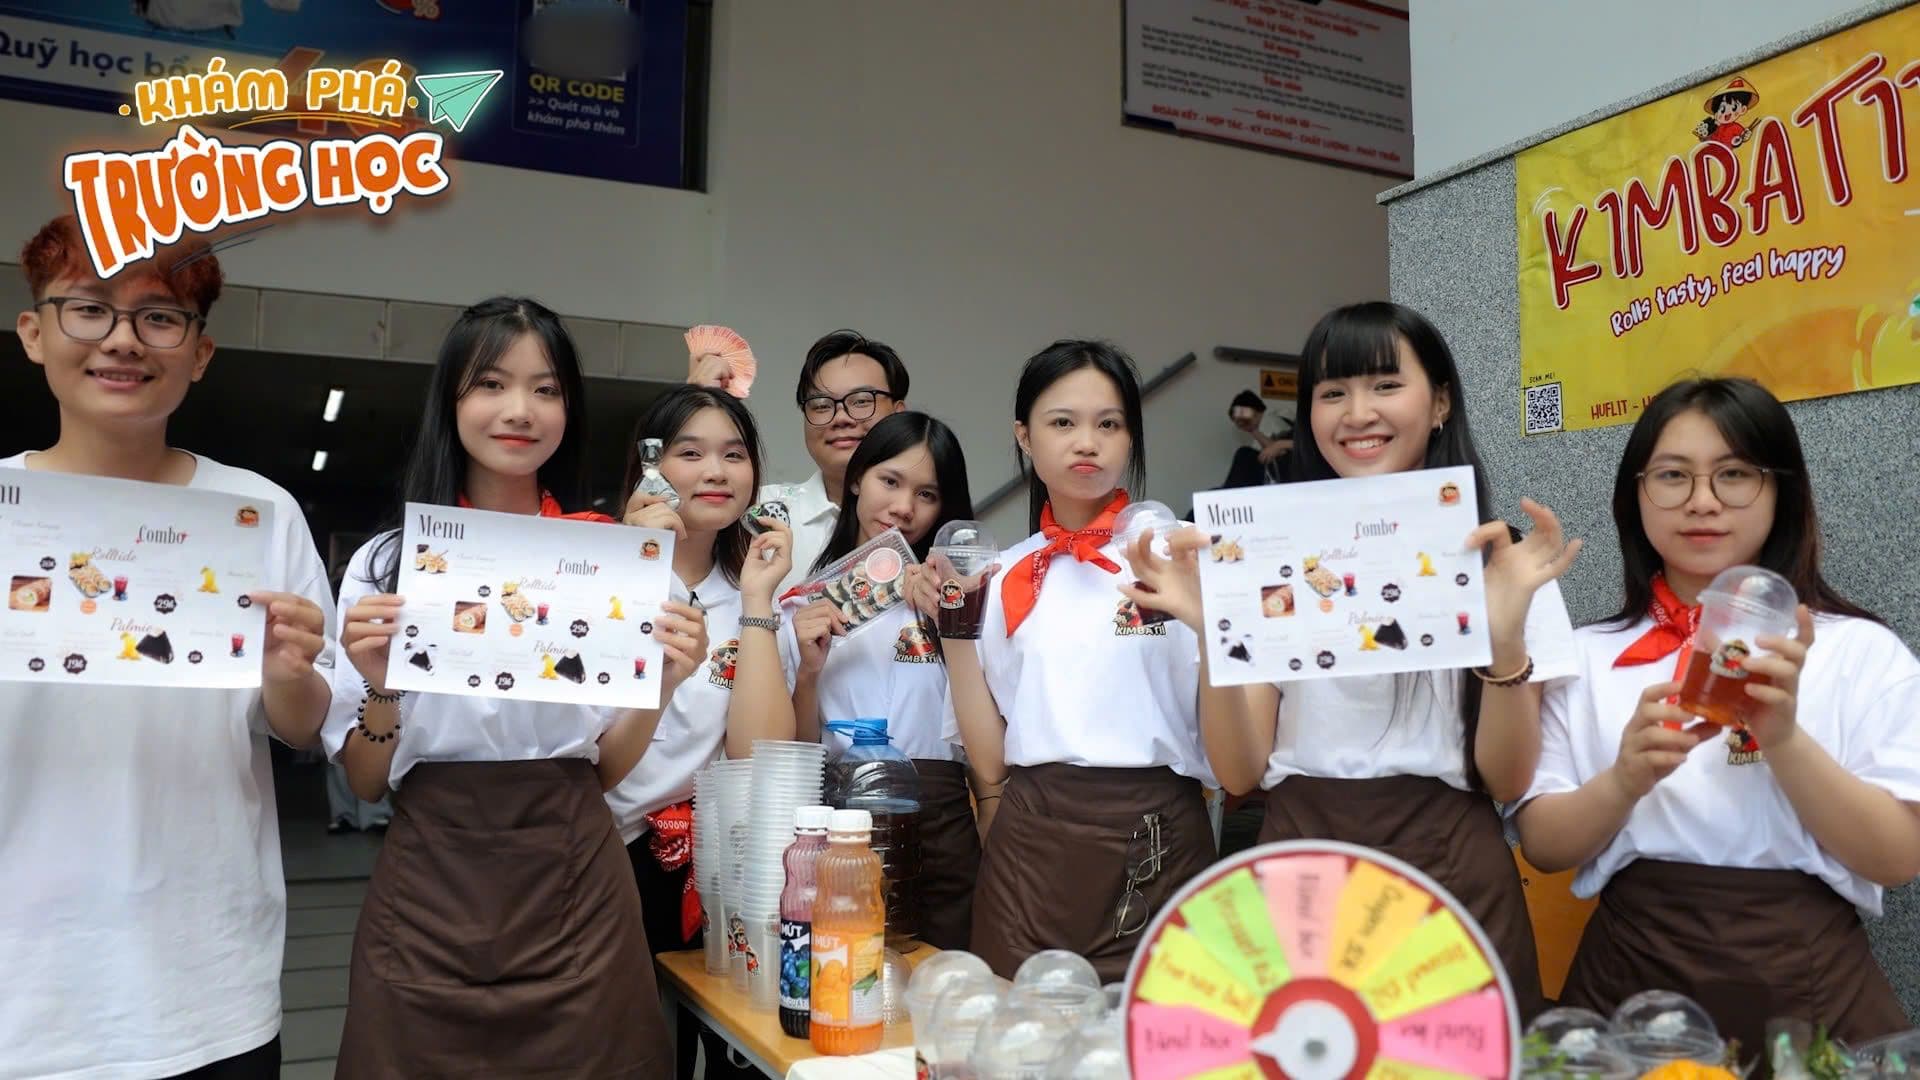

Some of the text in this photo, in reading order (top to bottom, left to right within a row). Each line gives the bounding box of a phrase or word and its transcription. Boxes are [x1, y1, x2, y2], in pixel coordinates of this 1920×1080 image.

[0, 31, 59, 69] Quỹ
[70, 40, 133, 78] học
[528, 73, 625, 103] QR CODE
[1610, 245, 1846, 338] Rolls tasty, feel happy
[1590, 399, 1628, 421] HUFLIT
[417, 514, 464, 540] Menu
[1207, 504, 1255, 528] Menu
[1355, 518, 1398, 538] Combo
[138, 525, 187, 544] Combo
[558, 558, 598, 576] Combo
